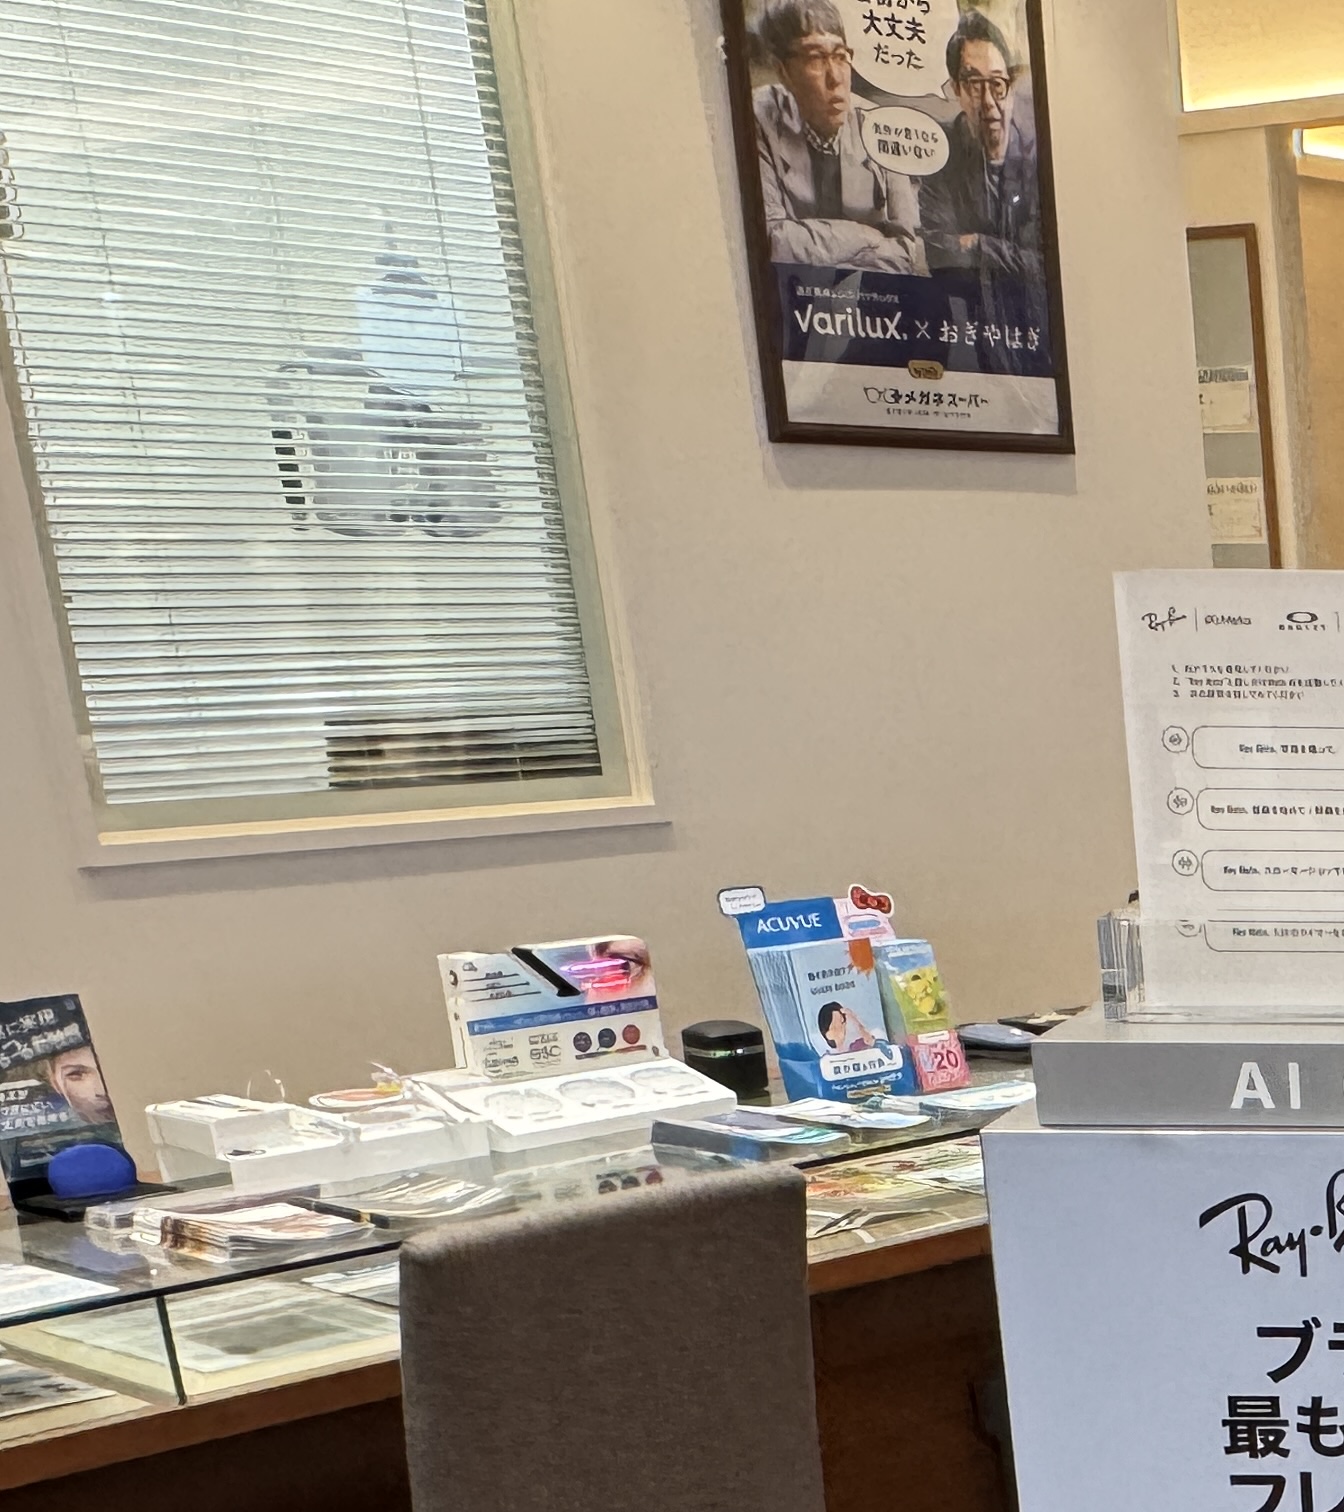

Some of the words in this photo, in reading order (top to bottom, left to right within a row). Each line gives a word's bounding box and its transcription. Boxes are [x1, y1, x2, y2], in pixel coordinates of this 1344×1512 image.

[862, 9, 927, 44] 大丈夫
[873, 43, 925, 70] だった
[757, 912, 823, 934] ACUVUE
[1230, 1062, 1301, 1110] AI
